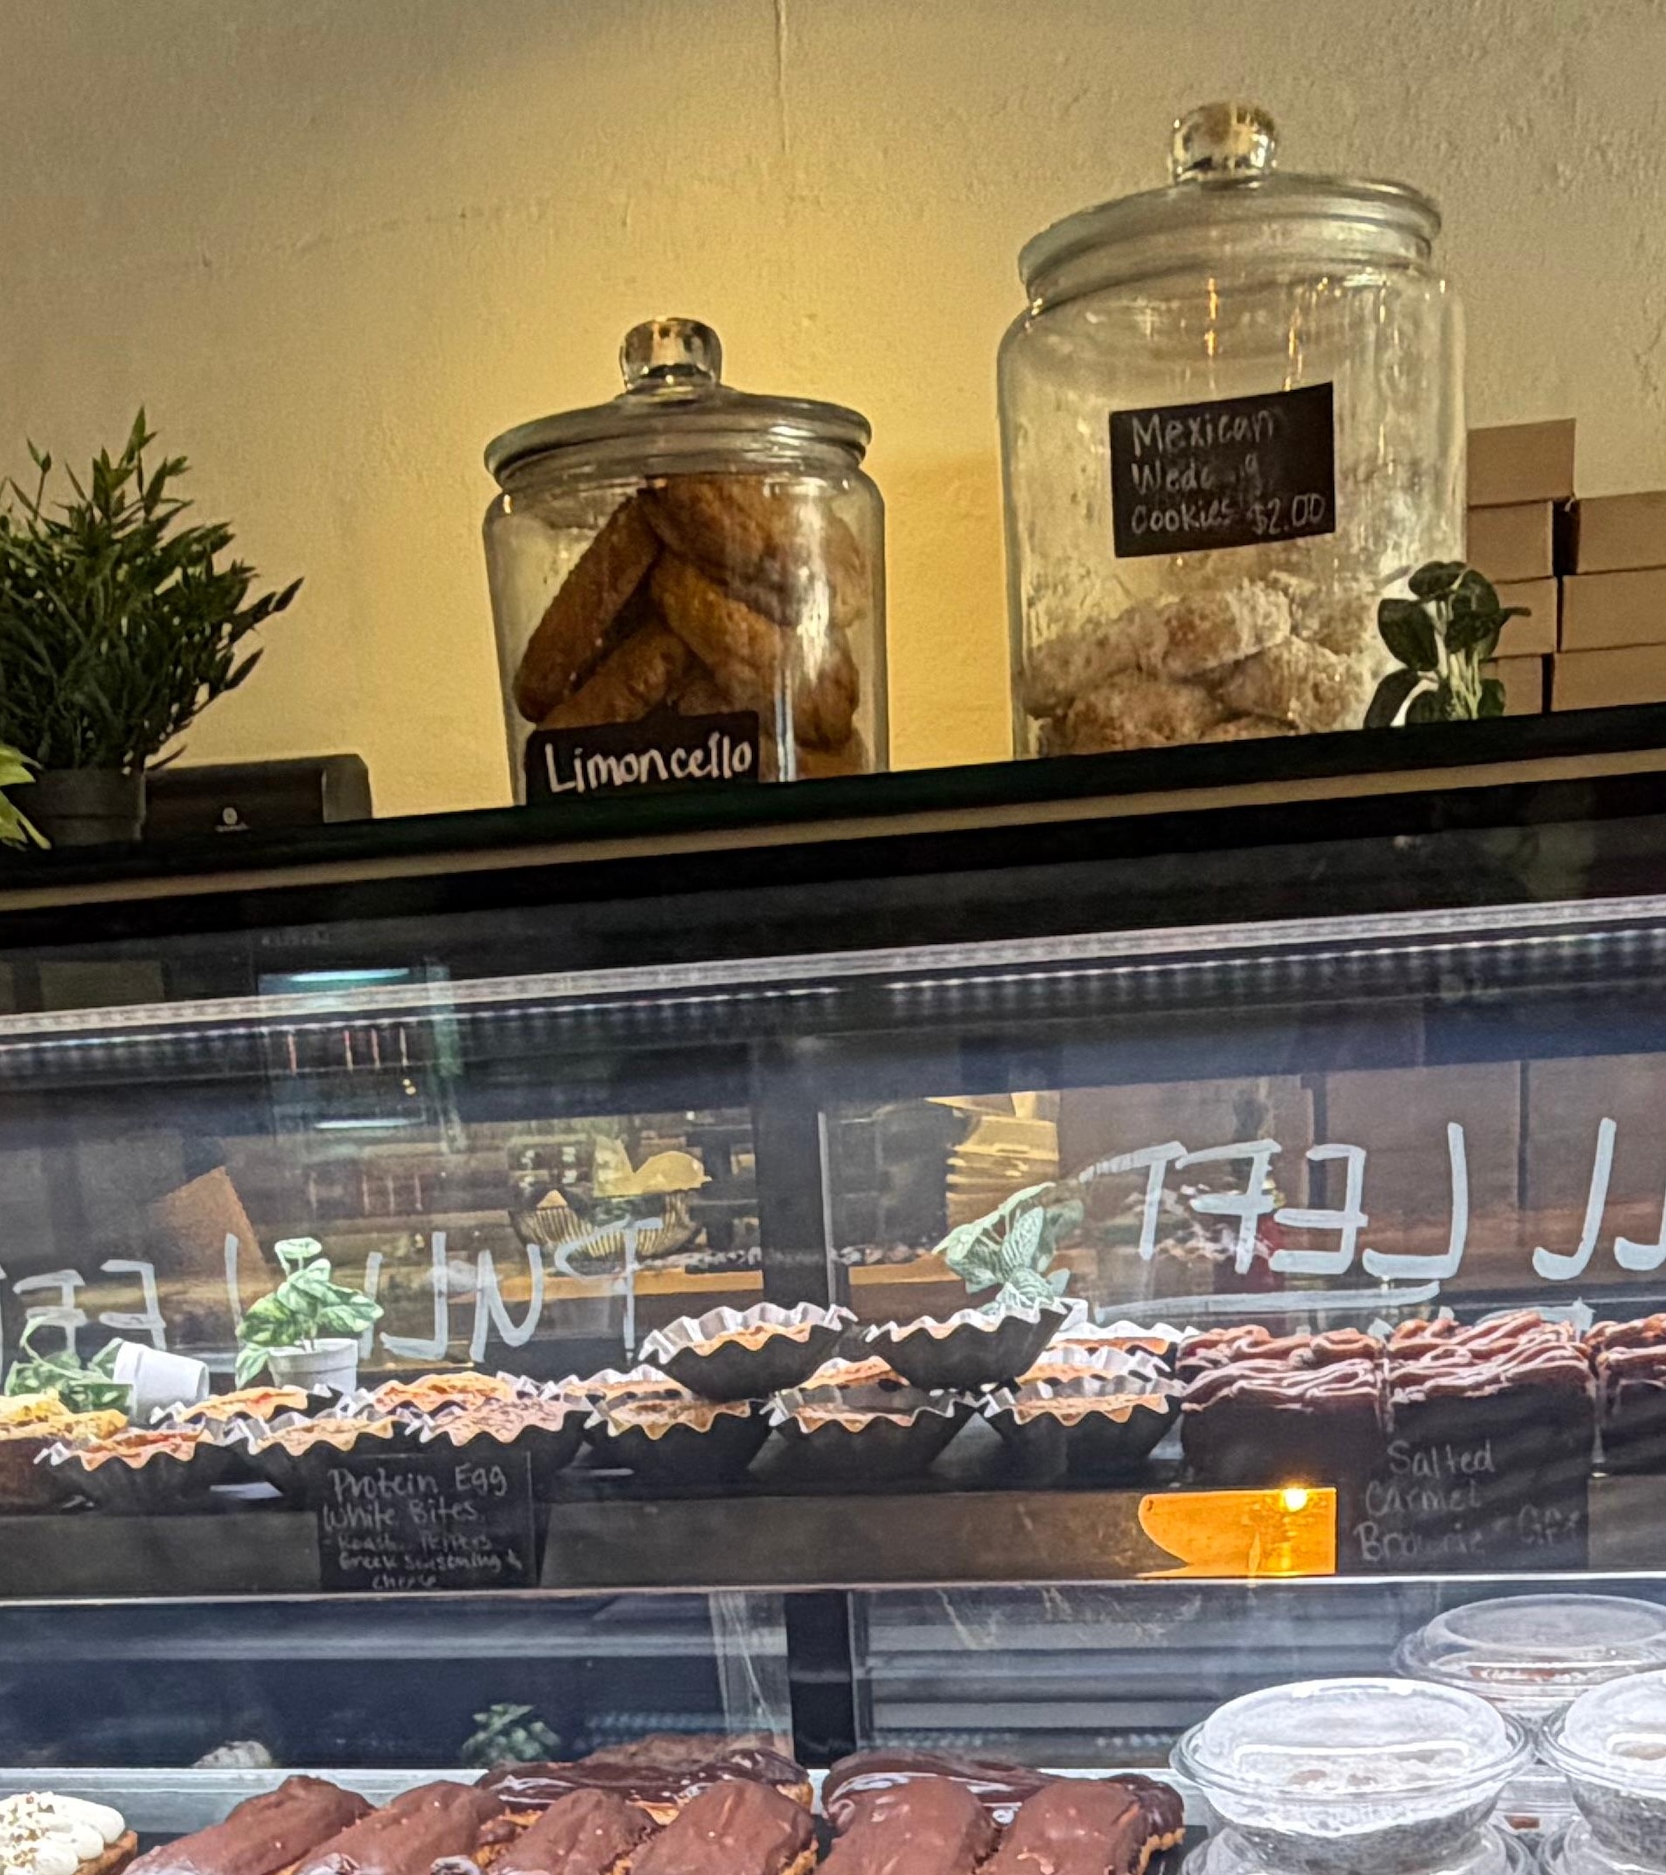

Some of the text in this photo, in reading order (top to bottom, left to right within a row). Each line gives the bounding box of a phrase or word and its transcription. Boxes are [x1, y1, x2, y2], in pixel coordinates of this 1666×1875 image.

[1132, 410, 1274, 457] Mexican
[1132, 492, 1326, 536] Cookies $2.00
[544, 730, 753, 794] Limoncello
[1386, 1438, 1496, 1479] Salted
[328, 1461, 509, 1503] Protein Egg
[1365, 1479, 1484, 1517] Carmel
[322, 1495, 480, 1533] White Bites
